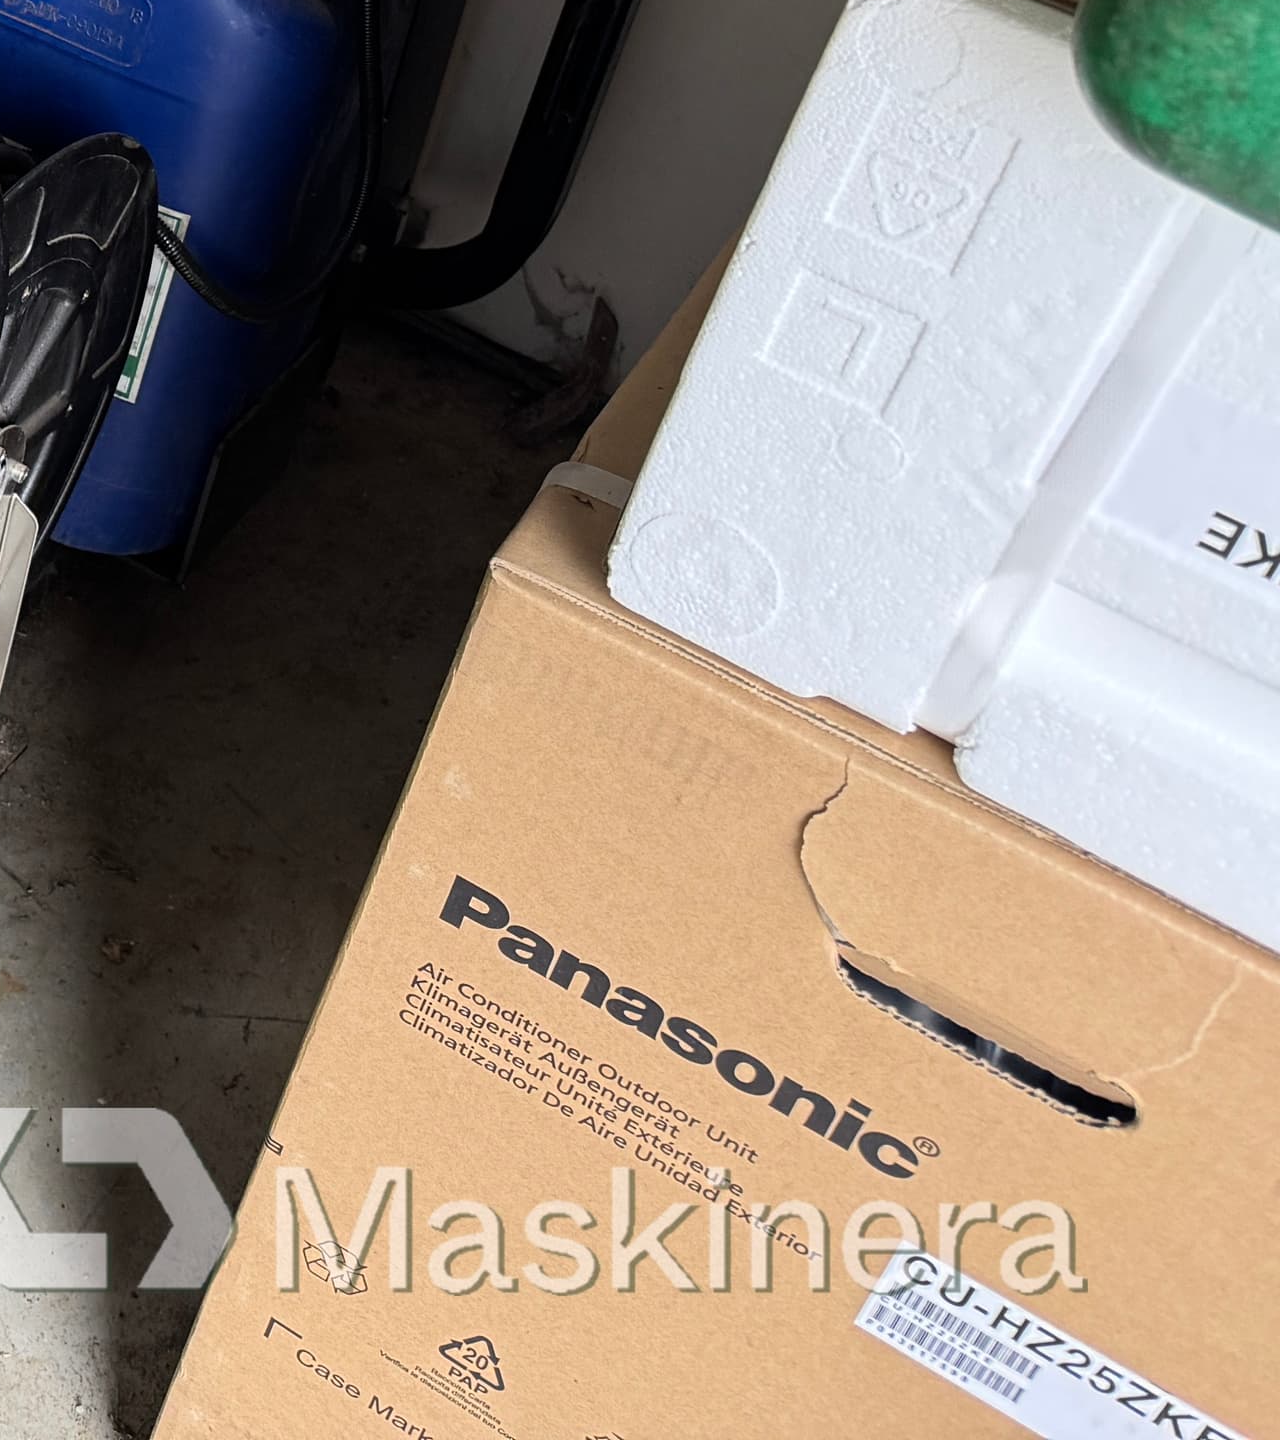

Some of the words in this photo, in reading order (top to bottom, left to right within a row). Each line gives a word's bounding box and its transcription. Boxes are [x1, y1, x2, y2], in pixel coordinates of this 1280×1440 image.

[409, 973, 534, 1056] Klimagerät
[537, 1047, 681, 1141] Außengerät
[416, 957, 454, 988] Air
[455, 979, 593, 1068] Conditioner
[595, 1060, 702, 1131] Outdoor
[704, 1123, 760, 1165] Unit
[438, 874, 920, 1180] Panasonic
[396, 1006, 539, 1099] Climatizador
[540, 1090, 574, 1119] De
[576, 1110, 629, 1150] Aire
[631, 1142, 721, 1204] Unidad
[724, 1196, 822, 1262] Exterior
[403, 990, 552, 1086] Climatisateur
[554, 1077, 618, 1124] Unité
[622, 1116, 746, 1198] Extérieure
[295, 1348, 361, 1400] Case
[368, 1395, 434, 1440] Mark
[378, 1349, 410, 1373] Verifica
[410, 1370, 419, 1379] le
[418, 1376, 467, 1411] disposizioni
[467, 1408, 481, 1420] del
[481, 1417, 496, 1430] tuo
[414, 1365, 451, 1392] Raccolta
[450, 1389, 502, 1425] differenziata
[430, 1367, 467, 1394] Raccolta
[467, 1391, 491, 1410] Carta
[447, 1365, 489, 1398] PAP
[462, 1347, 489, 1370] 20
